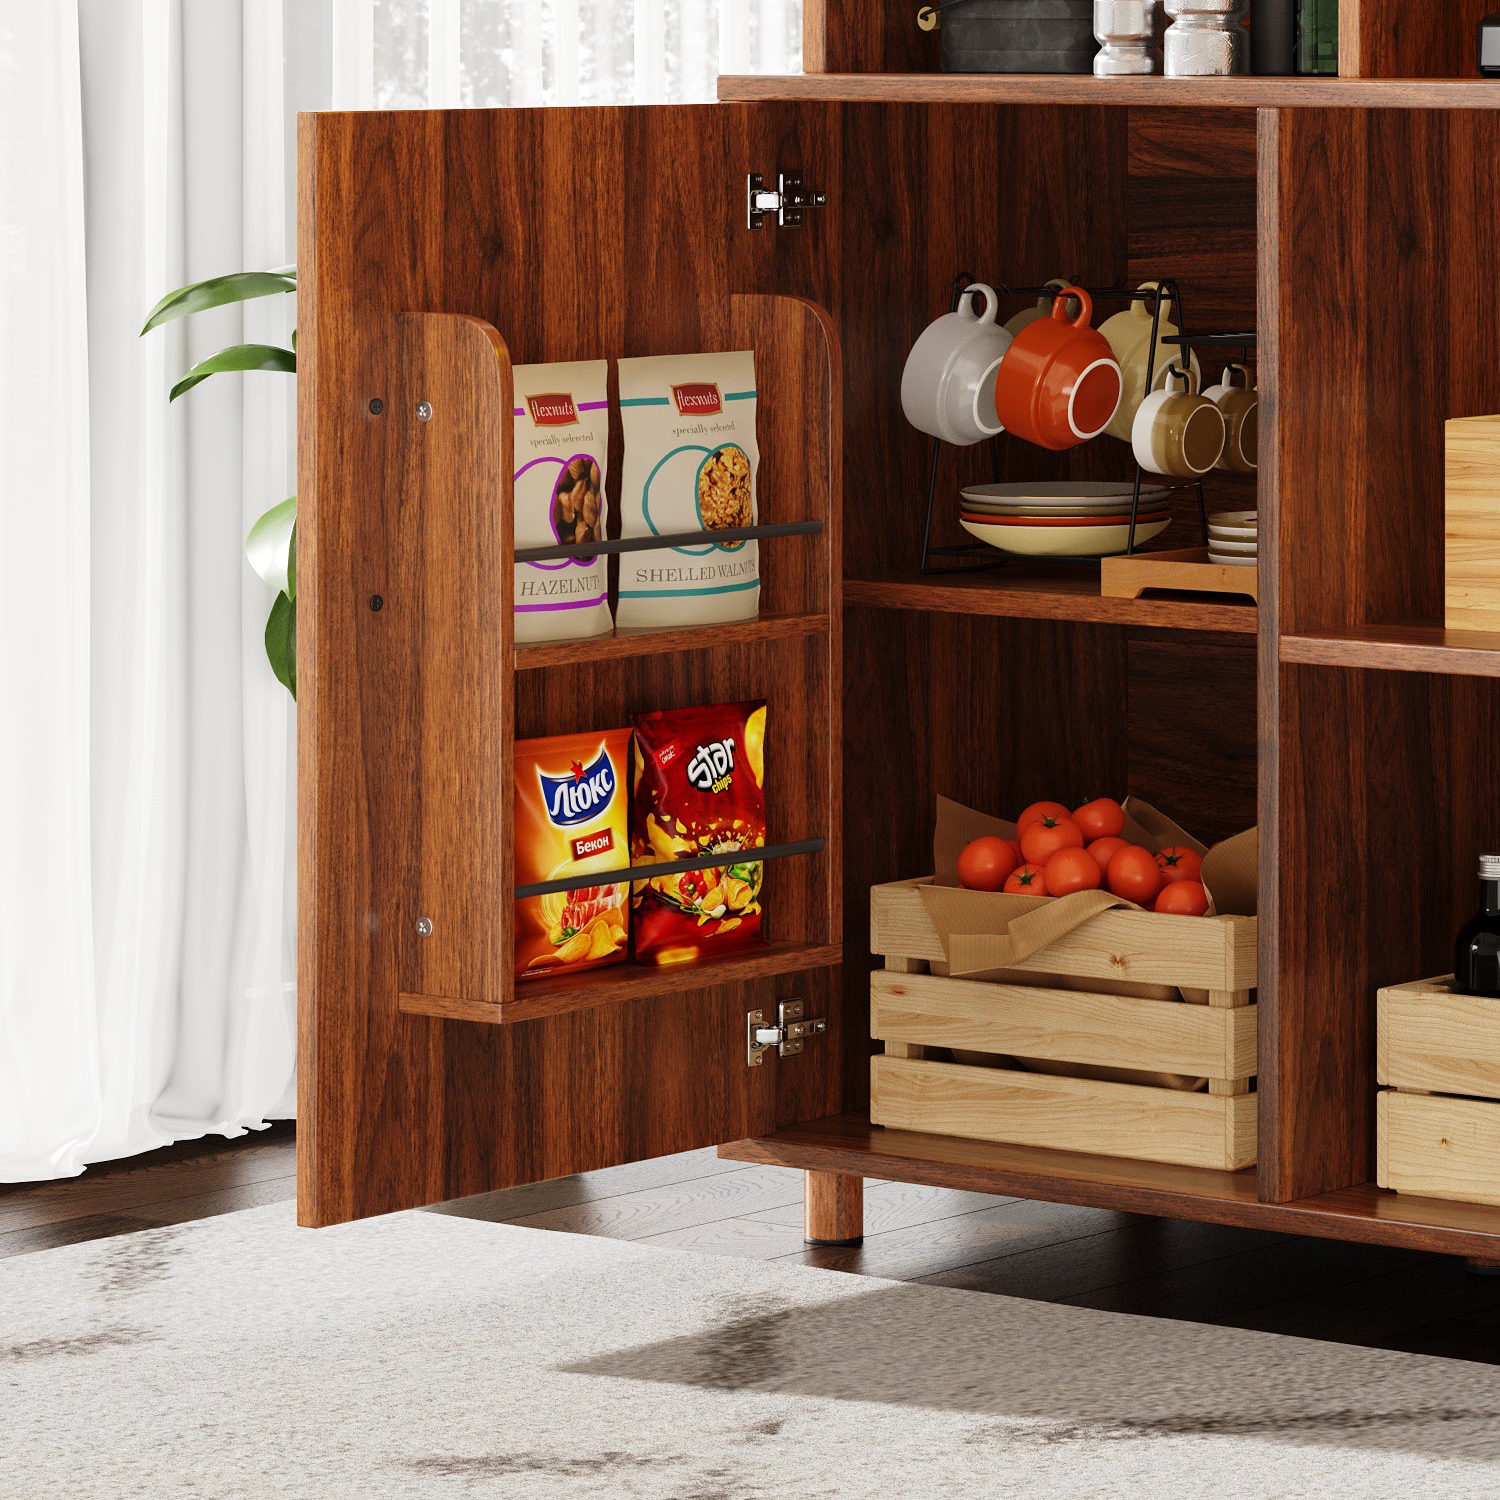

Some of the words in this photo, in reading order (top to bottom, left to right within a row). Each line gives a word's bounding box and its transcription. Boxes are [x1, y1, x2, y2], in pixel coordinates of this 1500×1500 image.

[677, 389, 718, 411] flexnuts
[531, 400, 574, 422] flexnuts
[672, 423, 708, 437] specially
[530, 434, 561, 449] specially
[636, 567, 716, 583] SHELLED
[717, 558, 756, 579] WALNUTS
[711, 773, 733, 794] chips
[576, 835, 610, 855] Бекон
